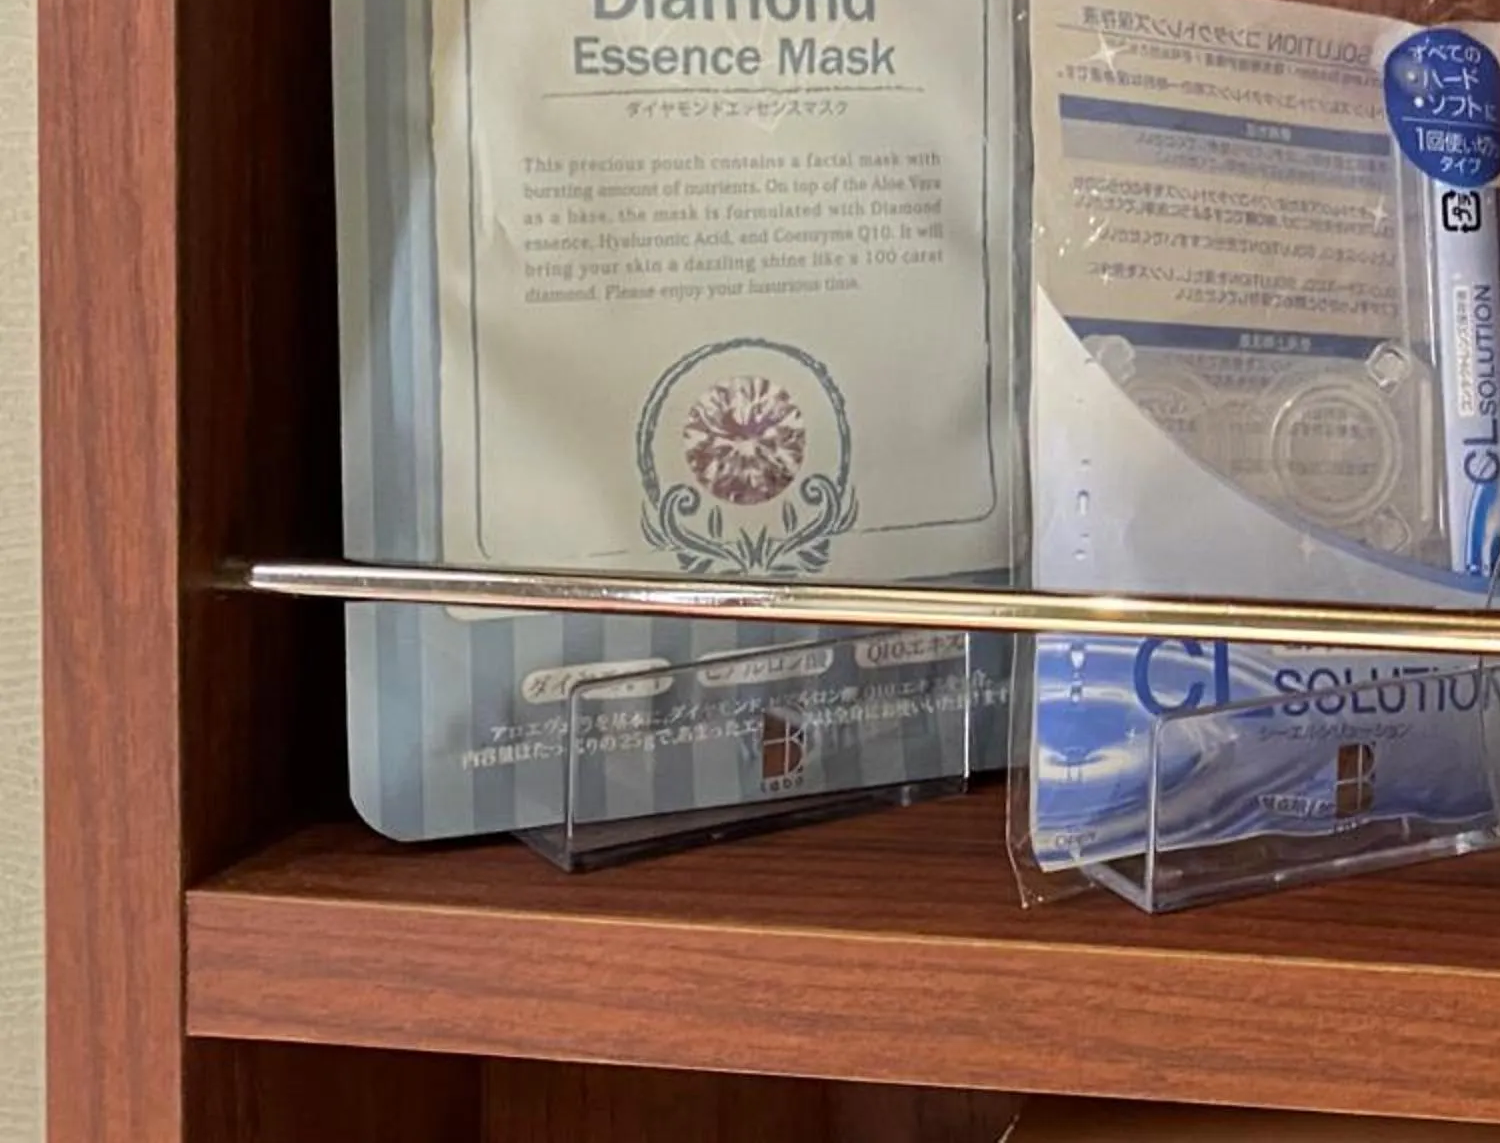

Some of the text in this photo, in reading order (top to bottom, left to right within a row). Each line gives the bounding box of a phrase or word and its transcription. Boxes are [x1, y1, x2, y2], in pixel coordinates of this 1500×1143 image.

[573, 35, 896, 77] Essence Mask
[1408, 38, 1482, 63] すべての
[525, 156, 562, 174] This
[568, 156, 645, 177] precious
[652, 154, 705, 174] pouch
[710, 153, 785, 170] contains
[523, 182, 594, 202] bursting
[662, 180, 681, 197] of
[765, 178, 788, 194] On
[823, 176, 840, 193] of
[523, 212, 543, 226] as
[704, 205, 719, 221] is
[725, 202, 822, 221] formulated
[870, 198, 942, 218] Diamond
[598, 232, 690, 253] Hyaluronic
[524, 263, 573, 281] bring
[577, 262, 620, 279] your
[625, 257, 663, 274] skin
[760, 253, 806, 269] shine
[865, 249, 897, 265] 100
[659, 281, 707, 302] enjoy
[708, 280, 744, 299] your
[1473, 284, 1499, 417] SOLUTION
